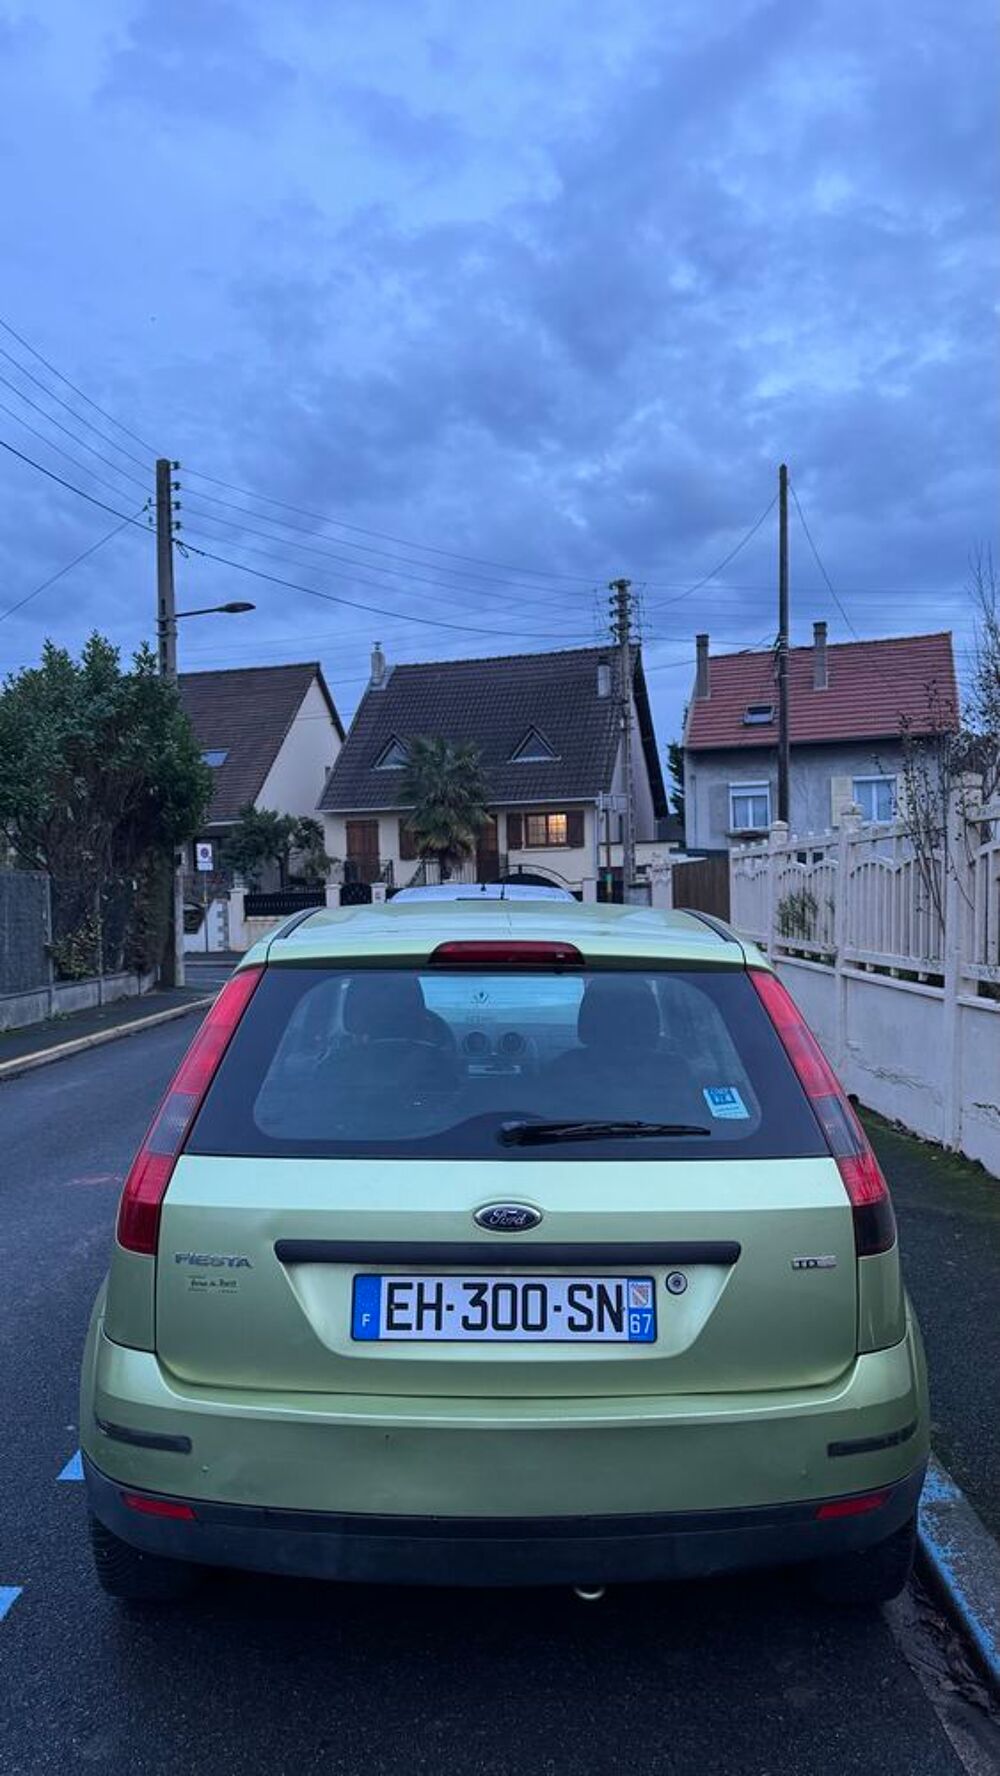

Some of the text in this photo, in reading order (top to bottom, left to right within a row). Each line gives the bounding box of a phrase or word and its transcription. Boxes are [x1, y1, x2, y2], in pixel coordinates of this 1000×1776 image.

[489, 1208, 527, 1225] Ford
[175, 1252, 253, 1269] FIESTA
[386, 1282, 624, 1332] EH-300-SN
[361, 1314, 370, 1327] F
[630, 1313, 652, 1334] 67
